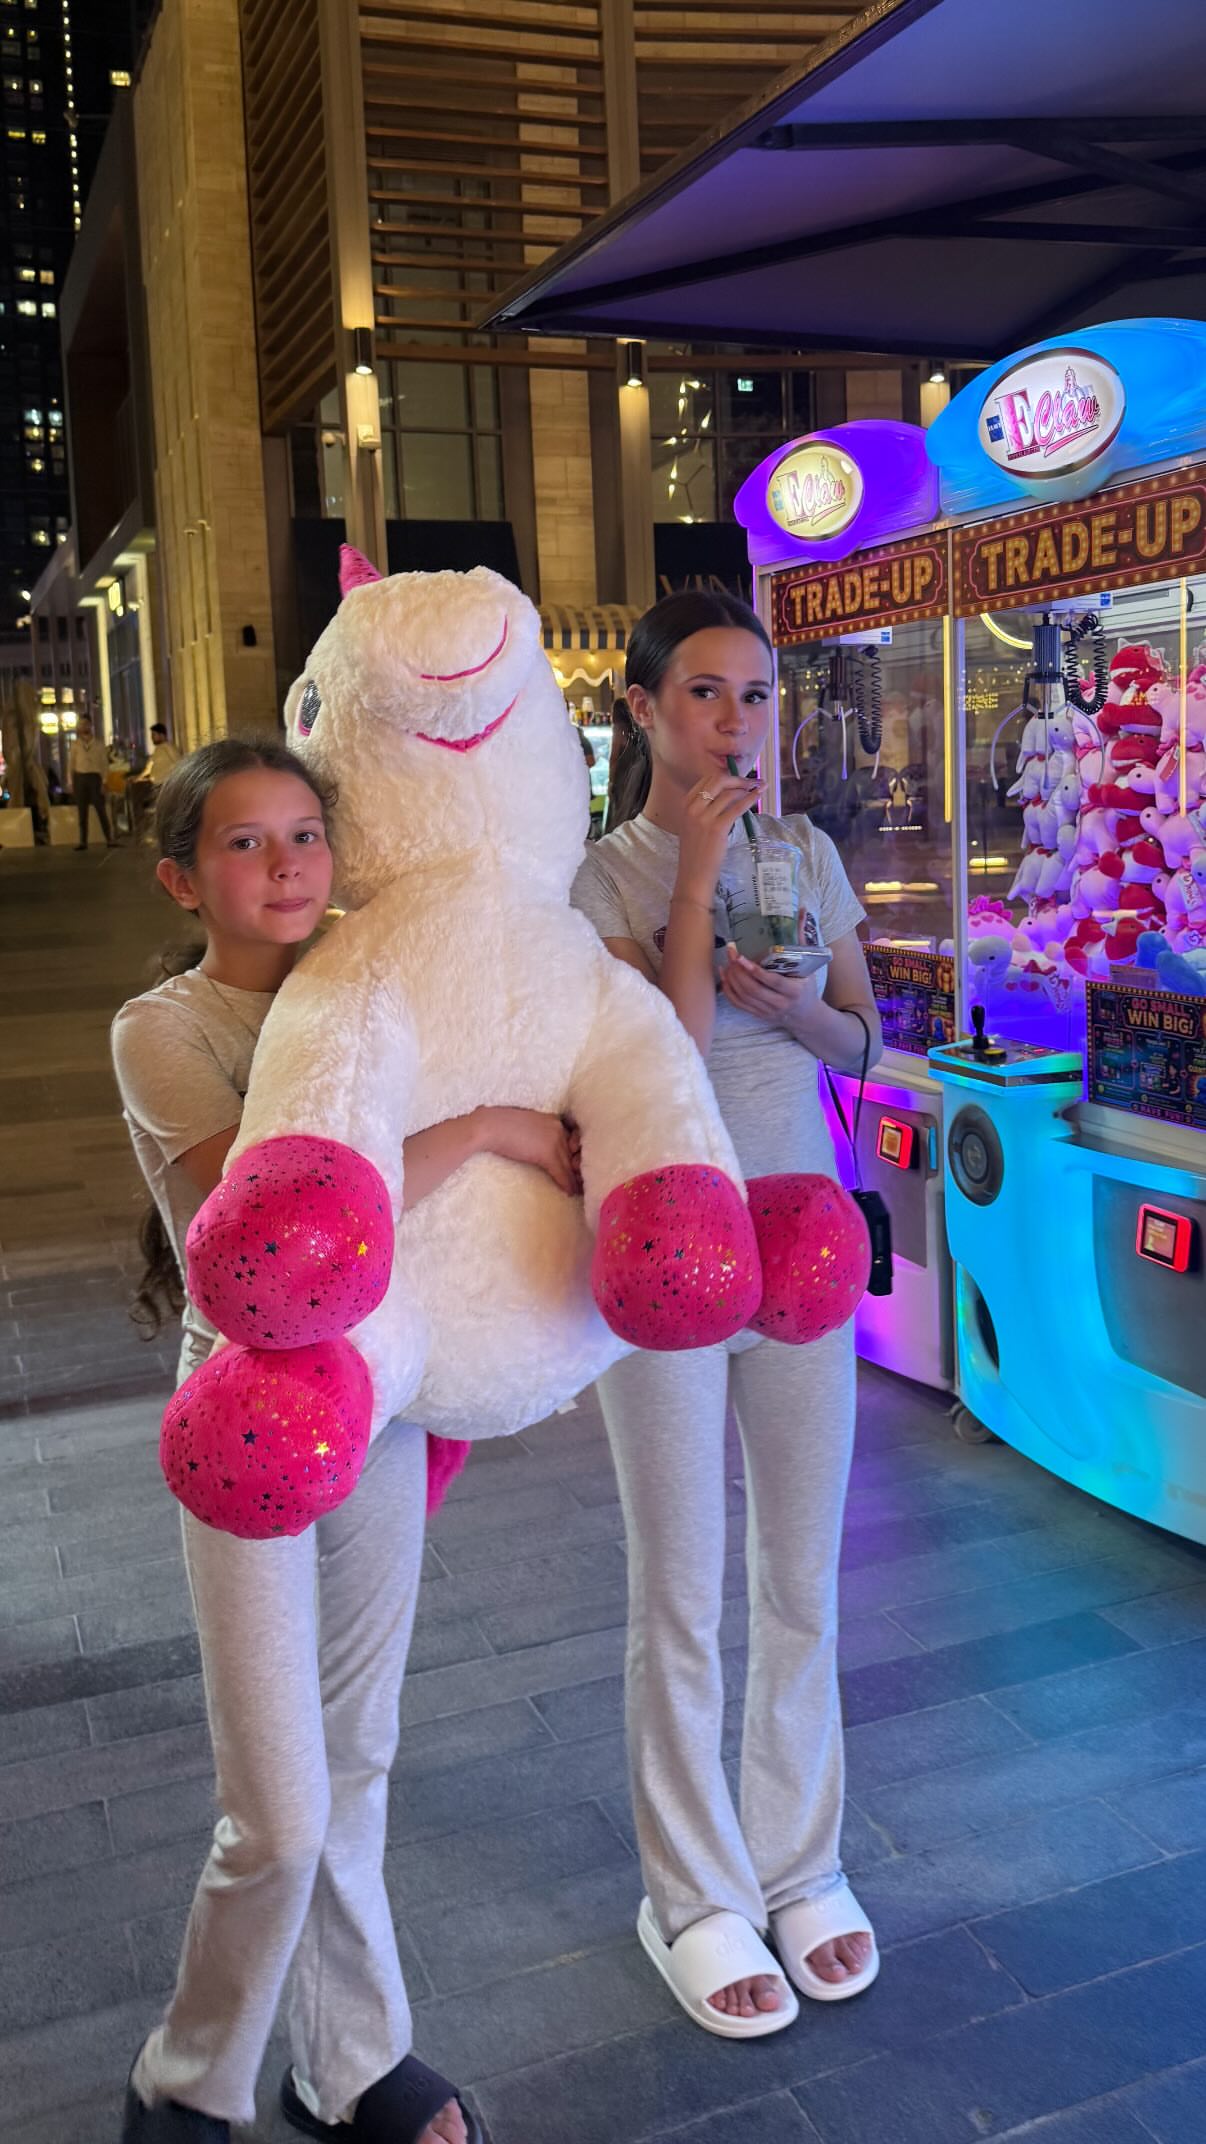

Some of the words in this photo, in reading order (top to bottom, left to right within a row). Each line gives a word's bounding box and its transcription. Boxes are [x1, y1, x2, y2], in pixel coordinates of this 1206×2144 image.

[980, 495, 1201, 591] TRADE-UP
[790, 556, 933, 625] TRADE-UP
[889, 965, 911, 981] WIN
[912, 968, 932, 985] BIG!
[1127, 1008, 1160, 1028] WIN
[1162, 1014, 1194, 1035] BIG!
[1131, 997, 1148, 1010] GO
[1150, 999, 1190, 1019] SMALL
